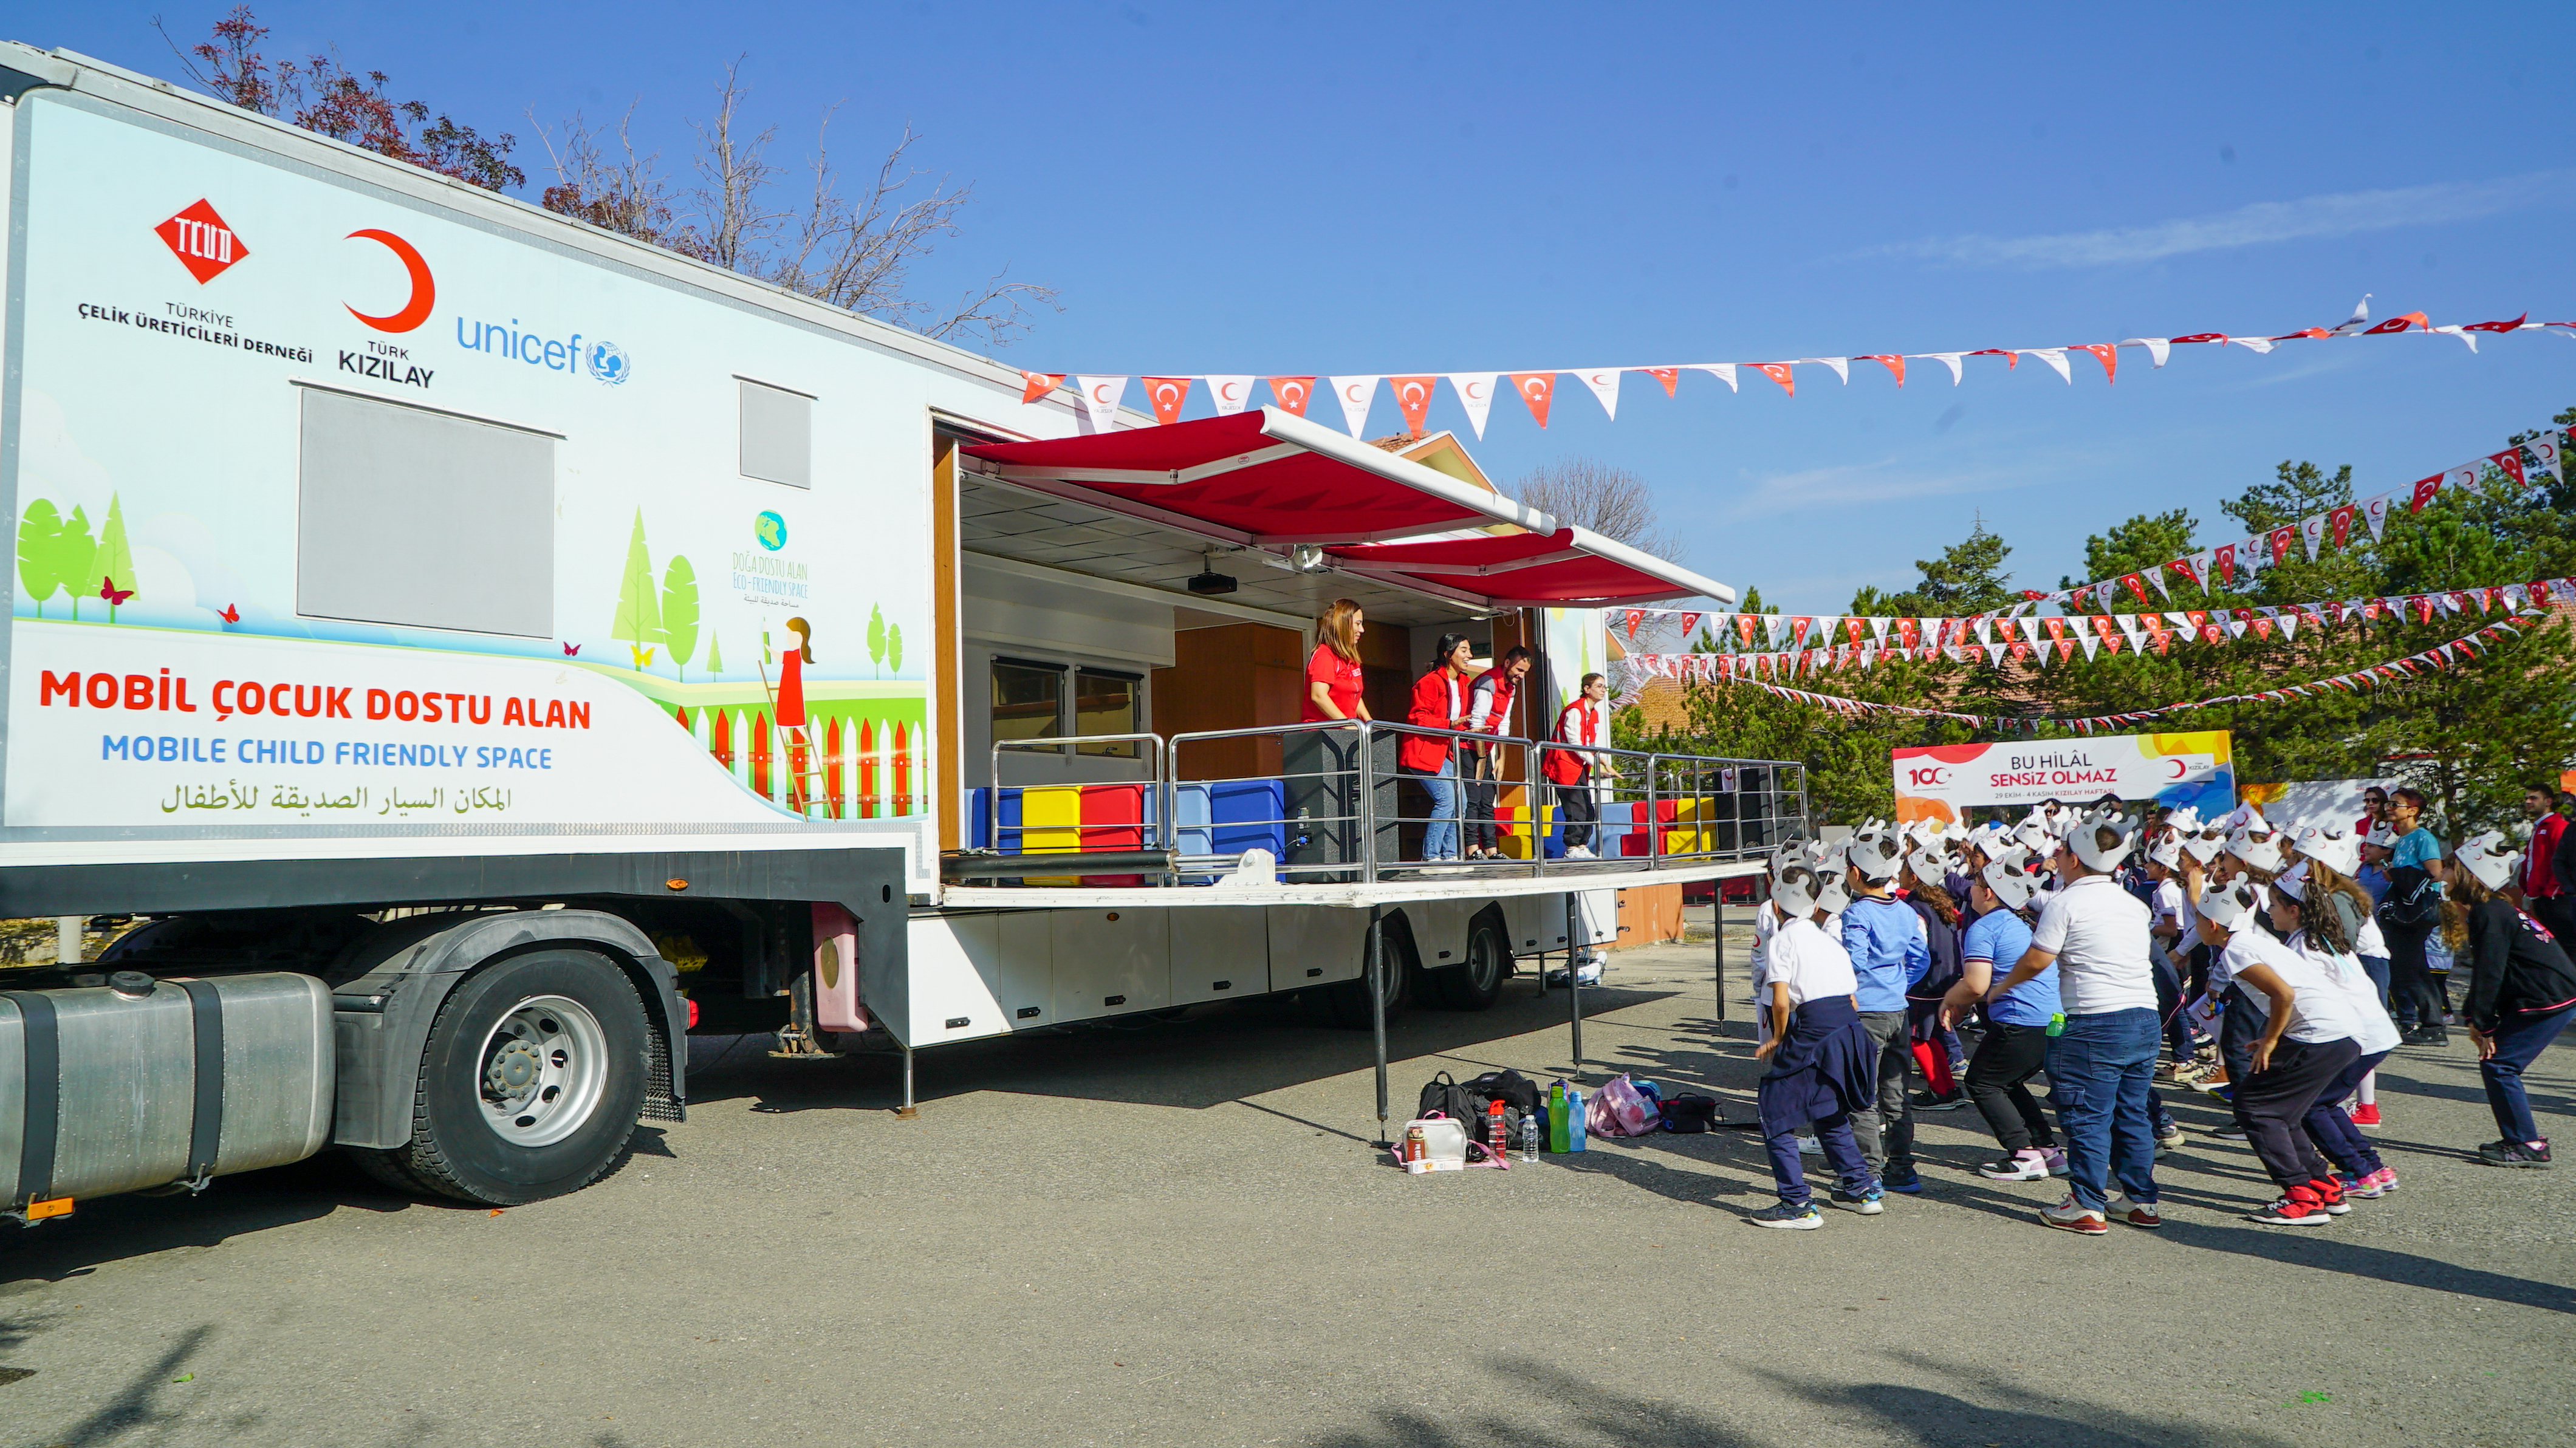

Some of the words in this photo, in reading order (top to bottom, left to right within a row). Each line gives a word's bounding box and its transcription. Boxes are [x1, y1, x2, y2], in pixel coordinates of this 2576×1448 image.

[165, 302, 233, 329] TÜRKİYE
[78, 302, 130, 325] ÇELİK
[135, 312, 238, 348] ÜRETİCİLERİ
[244, 338, 312, 364] DERNEĞİ
[457, 316, 582, 374] unicef
[367, 340, 409, 361] TÜRK
[339, 349, 434, 389] KIZILAY
[733, 550, 757, 573] DOĞA
[759, 556, 785, 578] DOSTU
[787, 561, 808, 581] ALAN
[761, 595, 779, 606] صديقة
[781, 598, 800, 608] مساحة
[788, 581, 809, 599] SPACE
[39, 667, 197, 713] MOBİL
[212, 680, 354, 722] ÇOCUK
[366, 688, 492, 725] DOSTU
[502, 697, 590, 729] ALAN
[102, 734, 227, 763] MOBILE
[238, 738, 324, 765] CHILD
[335, 742, 468, 767] FRIENDLY
[476, 746, 551, 770] SPACE
[2011, 756, 2034, 770] BU
[2040, 750, 2092, 768] HİLÂL
[1990, 771, 2047, 787] SENSİZ
[2052, 768, 2117, 785] OLMAZ
[161, 779, 259, 813] للأطفال
[270, 785, 368, 818] الصديقة
[377, 787, 444, 816] السيار
[454, 786, 511, 814] المكان
